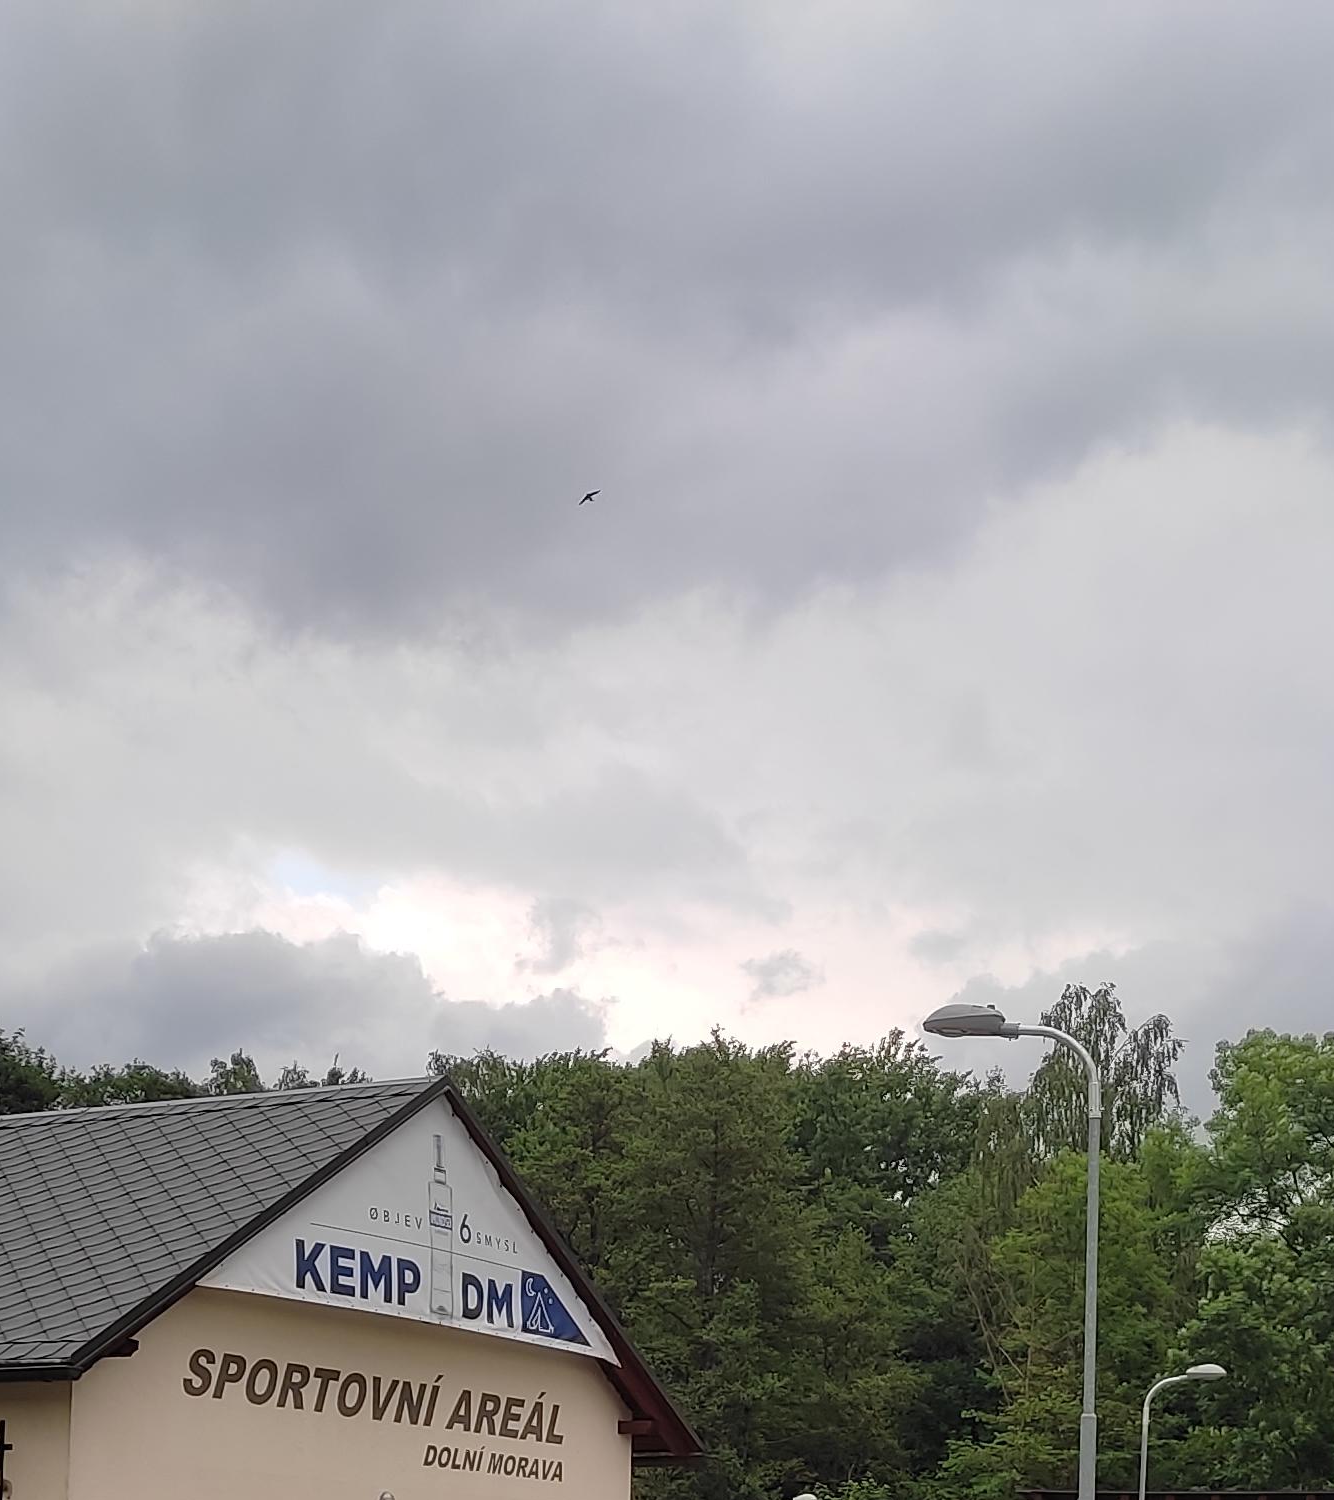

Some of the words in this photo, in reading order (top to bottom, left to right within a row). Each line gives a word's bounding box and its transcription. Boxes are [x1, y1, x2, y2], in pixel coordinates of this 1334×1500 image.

[476, 1231, 518, 1254] SMYSL
[295, 1238, 421, 1306] KEMP
[461, 1271, 515, 1329] DM
[182, 1347, 444, 1427] SPORTOVNÍ
[445, 1390, 566, 1446] AREÁL
[422, 1444, 486, 1473] DOLNÍ
[487, 1452, 565, 1483] MORAVA
